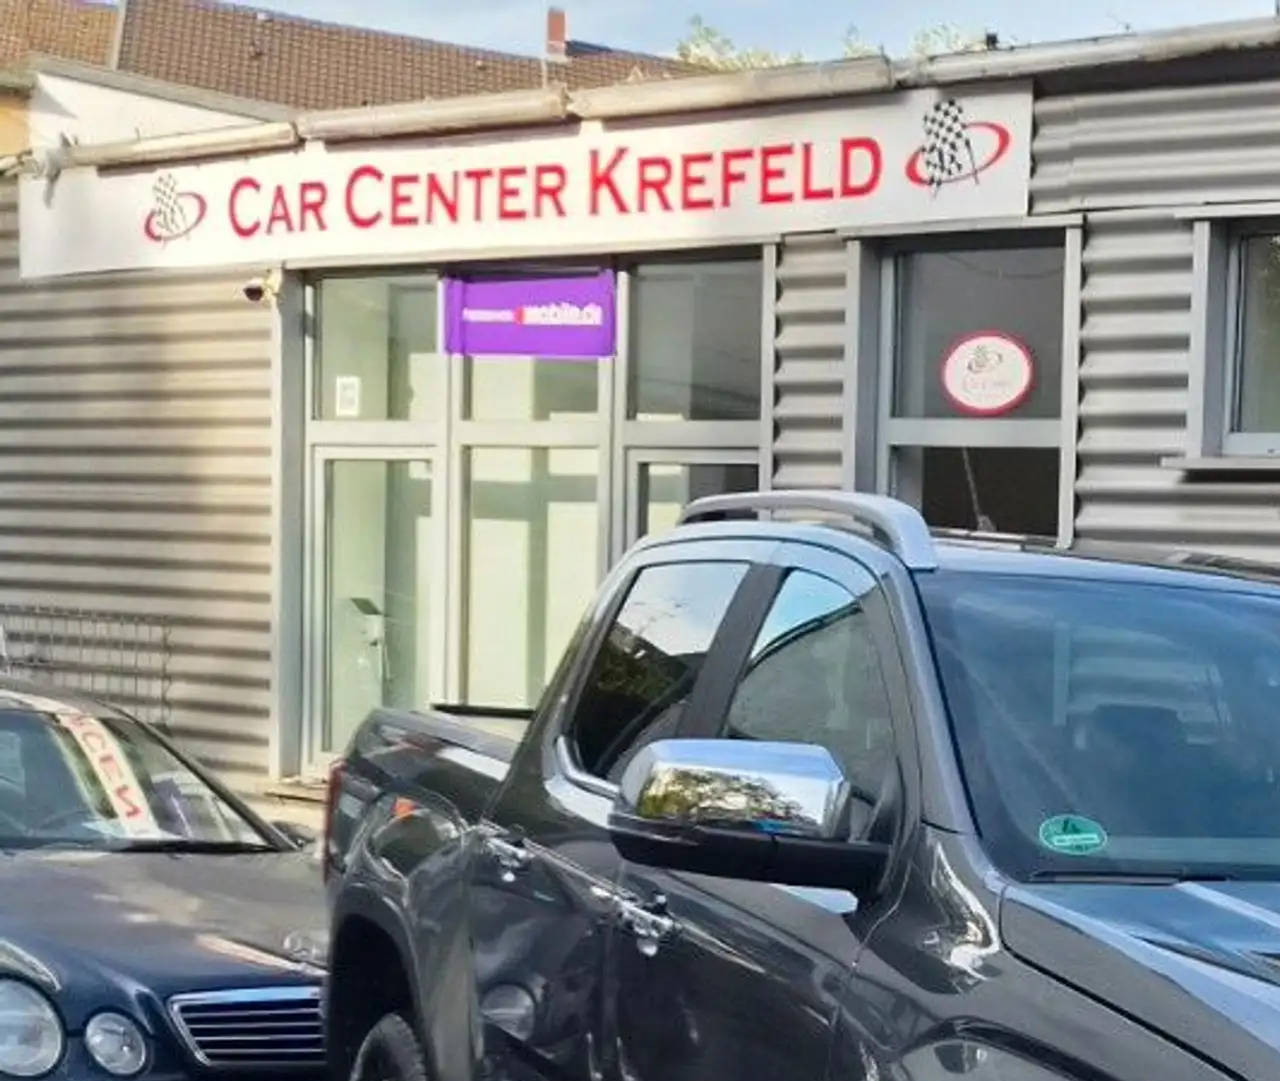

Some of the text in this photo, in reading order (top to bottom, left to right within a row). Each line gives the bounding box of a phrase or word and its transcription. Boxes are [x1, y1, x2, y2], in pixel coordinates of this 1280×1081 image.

[228, 138, 883, 237] CAR CENTER KREFELD
